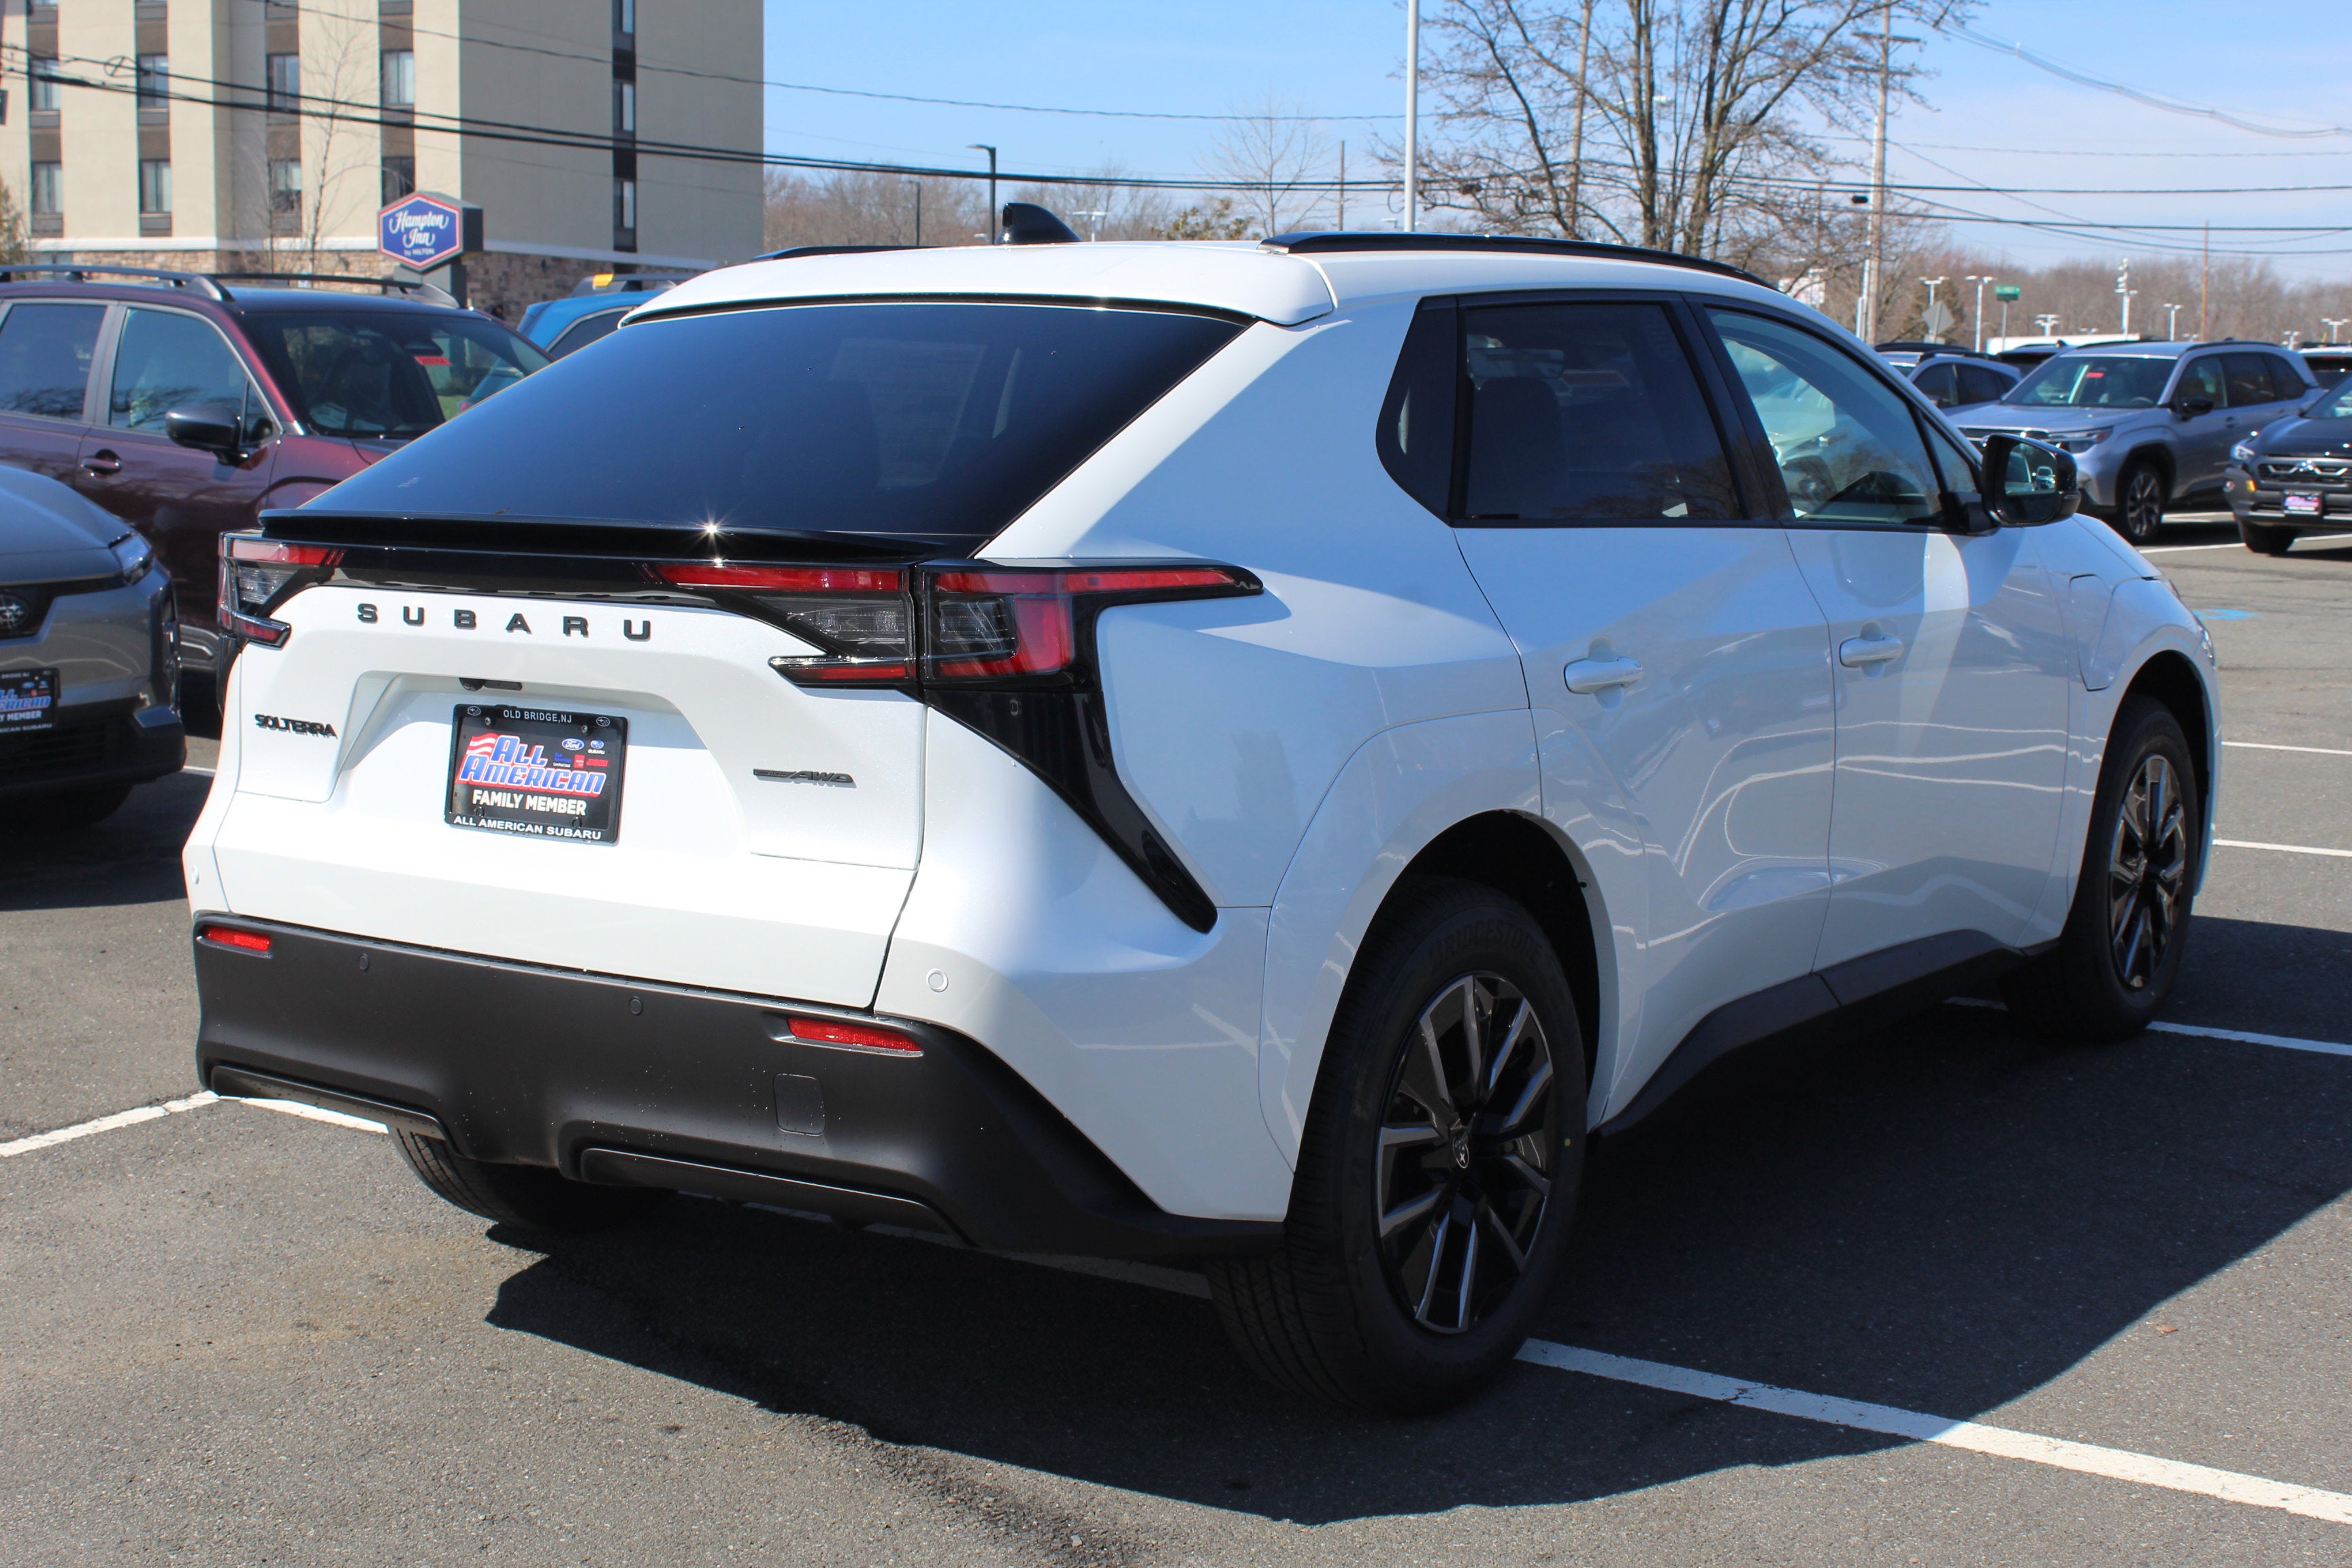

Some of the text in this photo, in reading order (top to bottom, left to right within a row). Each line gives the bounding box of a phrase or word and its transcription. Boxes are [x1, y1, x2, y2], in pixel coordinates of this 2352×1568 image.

[389, 210, 450, 233] Hampton
[403, 228, 436, 248] Inn
[357, 602, 651, 642] SUBARU
[6, 710, 42, 721] MEMBER
[255, 714, 337, 738] SOLTERRA
[503, 709, 521, 719] OLD
[491, 734, 548, 767] ALL
[565, 740, 581, 749] Ford
[459, 754, 607, 795] AMERICAN
[789, 770, 854, 783] AWD
[472, 789, 587, 816] FAMILY MEMBER
[453, 816, 602, 840] ALL AMERICAN SUBARU
[1428, 919, 1542, 975] BRIDGESTONE
